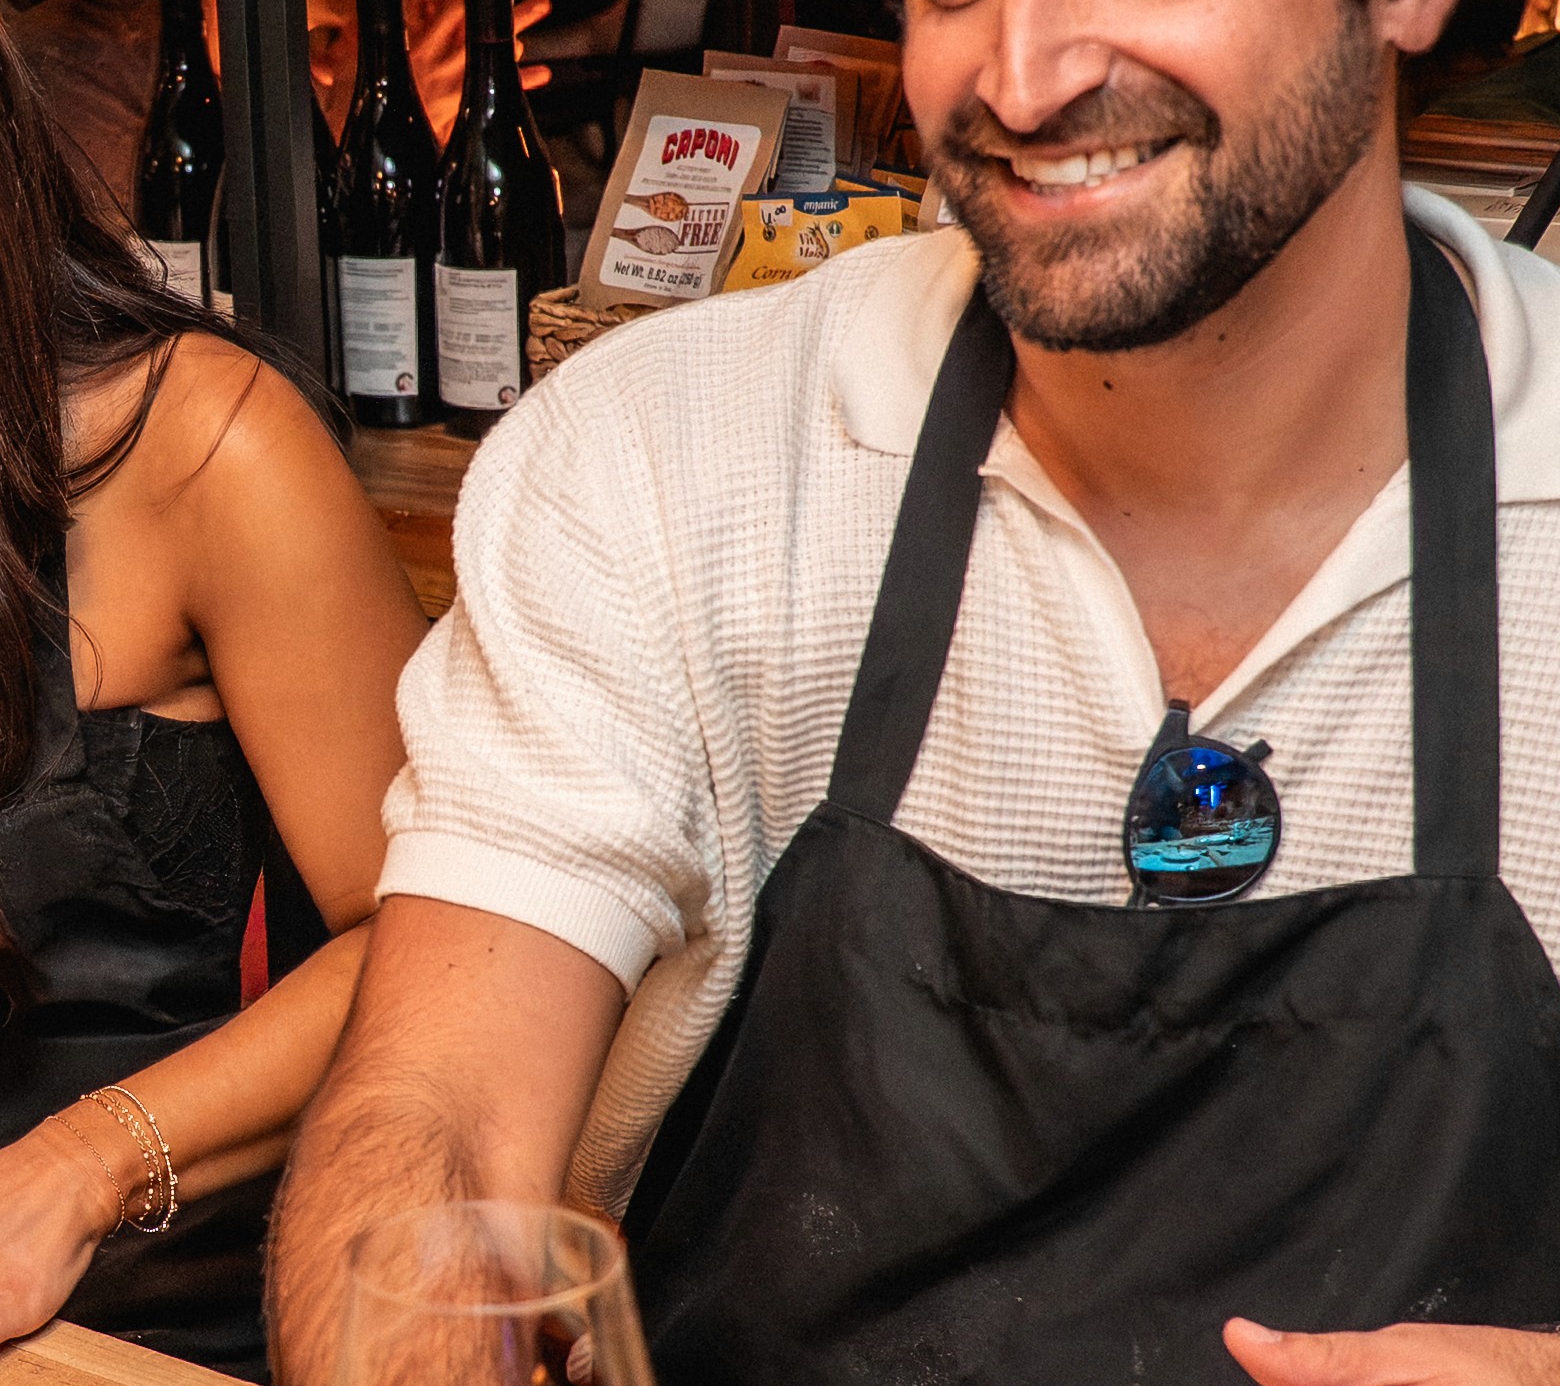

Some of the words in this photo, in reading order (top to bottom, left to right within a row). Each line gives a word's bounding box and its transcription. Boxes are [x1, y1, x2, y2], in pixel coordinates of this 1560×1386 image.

[662, 128, 740, 171] CAPONI
[803, 199, 839, 214] organic
[680, 222, 723, 247] FREE
[614, 261, 630, 275] Net
